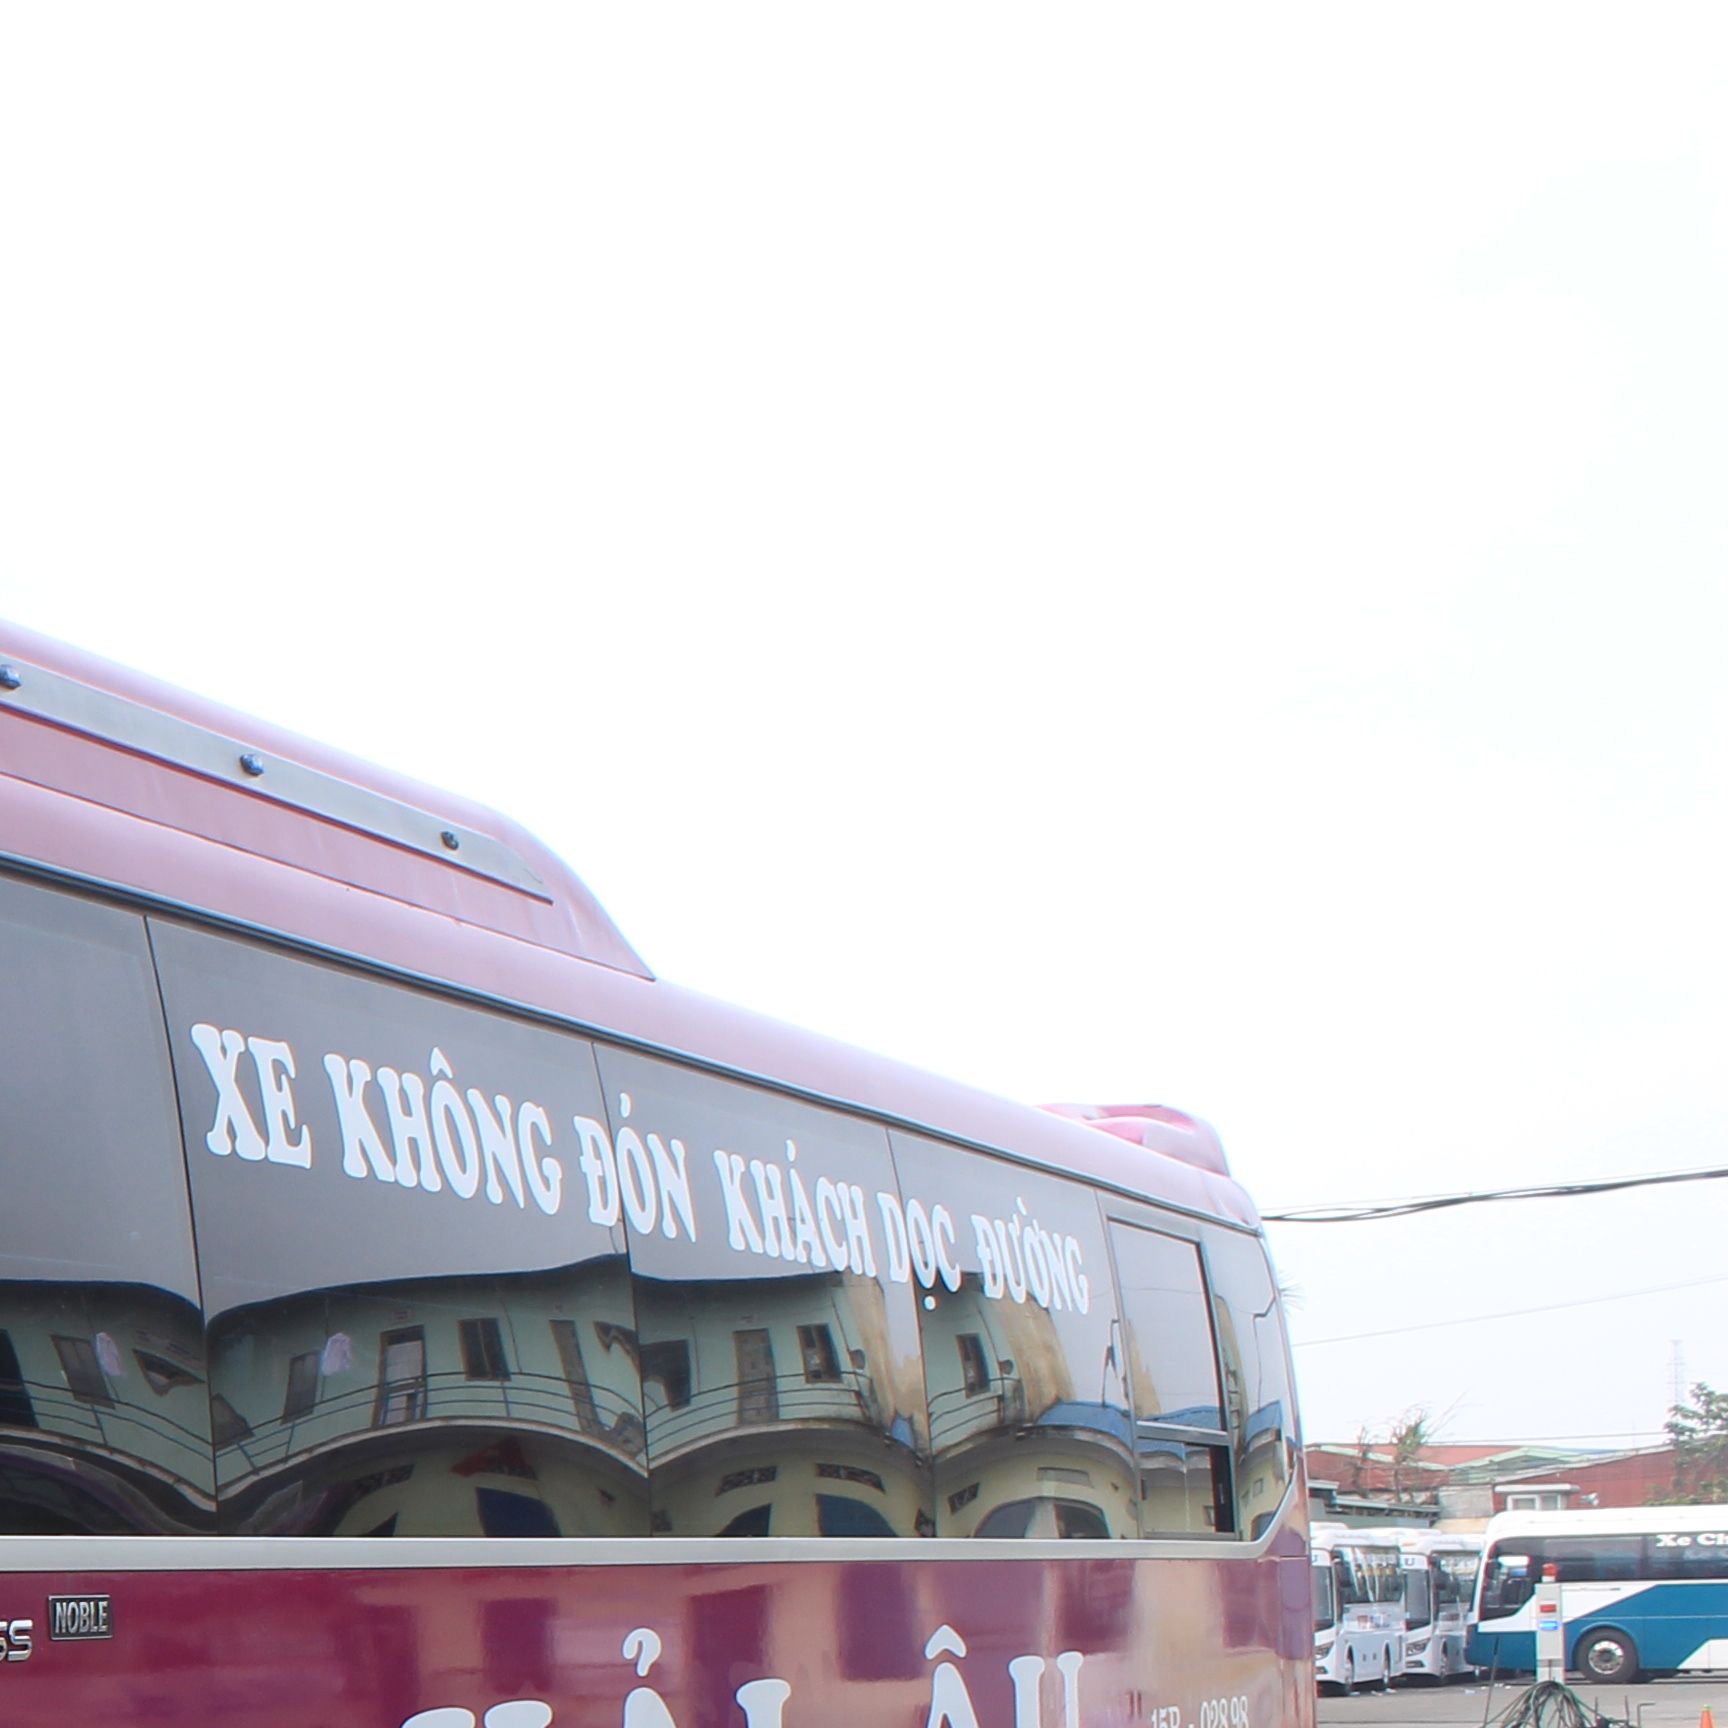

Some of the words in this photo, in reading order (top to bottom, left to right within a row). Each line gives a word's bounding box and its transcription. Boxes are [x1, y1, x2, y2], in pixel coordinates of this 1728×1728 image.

[189, 1022, 313, 1170] XE
[323, 1046, 562, 1215] KHÔNG
[572, 1092, 697, 1243] ĐÓN
[713, 1139, 877, 1278] KHÁCH
[876, 1191, 961, 1311] DỌC
[971, 1196, 1090, 1315] ĐƯỜNG
[54, 1600, 109, 1635] NOBLE
